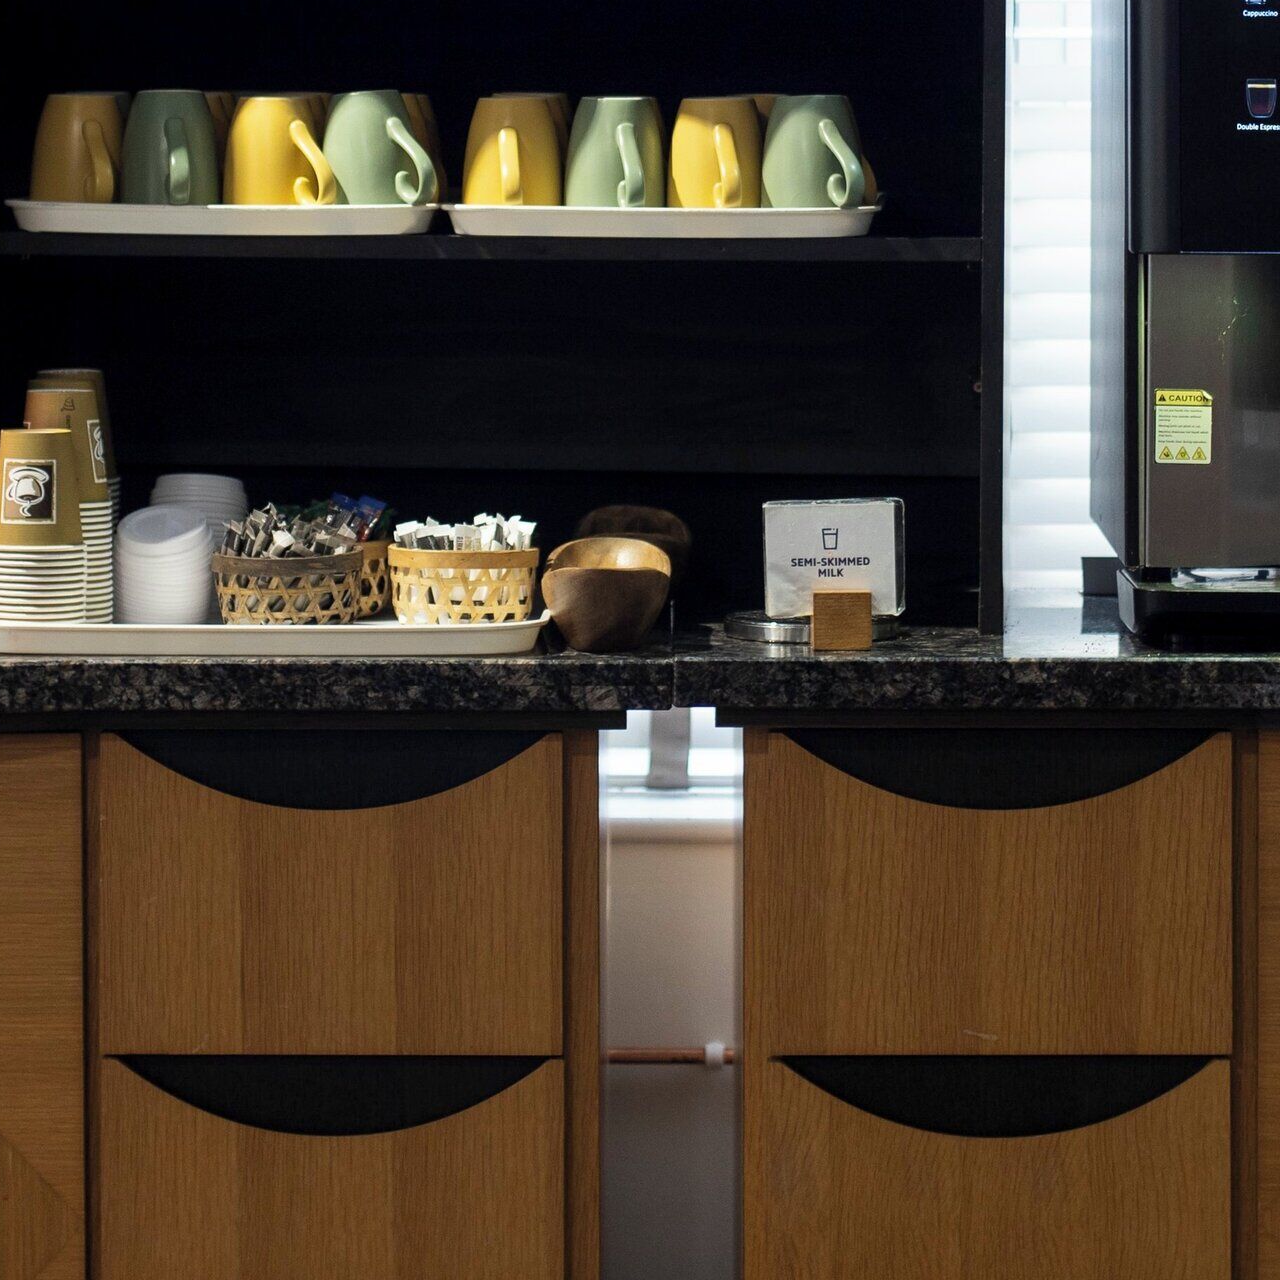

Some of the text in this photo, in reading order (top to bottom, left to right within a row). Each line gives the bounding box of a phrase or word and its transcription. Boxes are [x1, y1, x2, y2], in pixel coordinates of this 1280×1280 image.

[1243, 10, 1278, 18] Cappuccino
[791, 557, 870, 567] SEMI-SKIMMED
[818, 569, 844, 577] MILK
